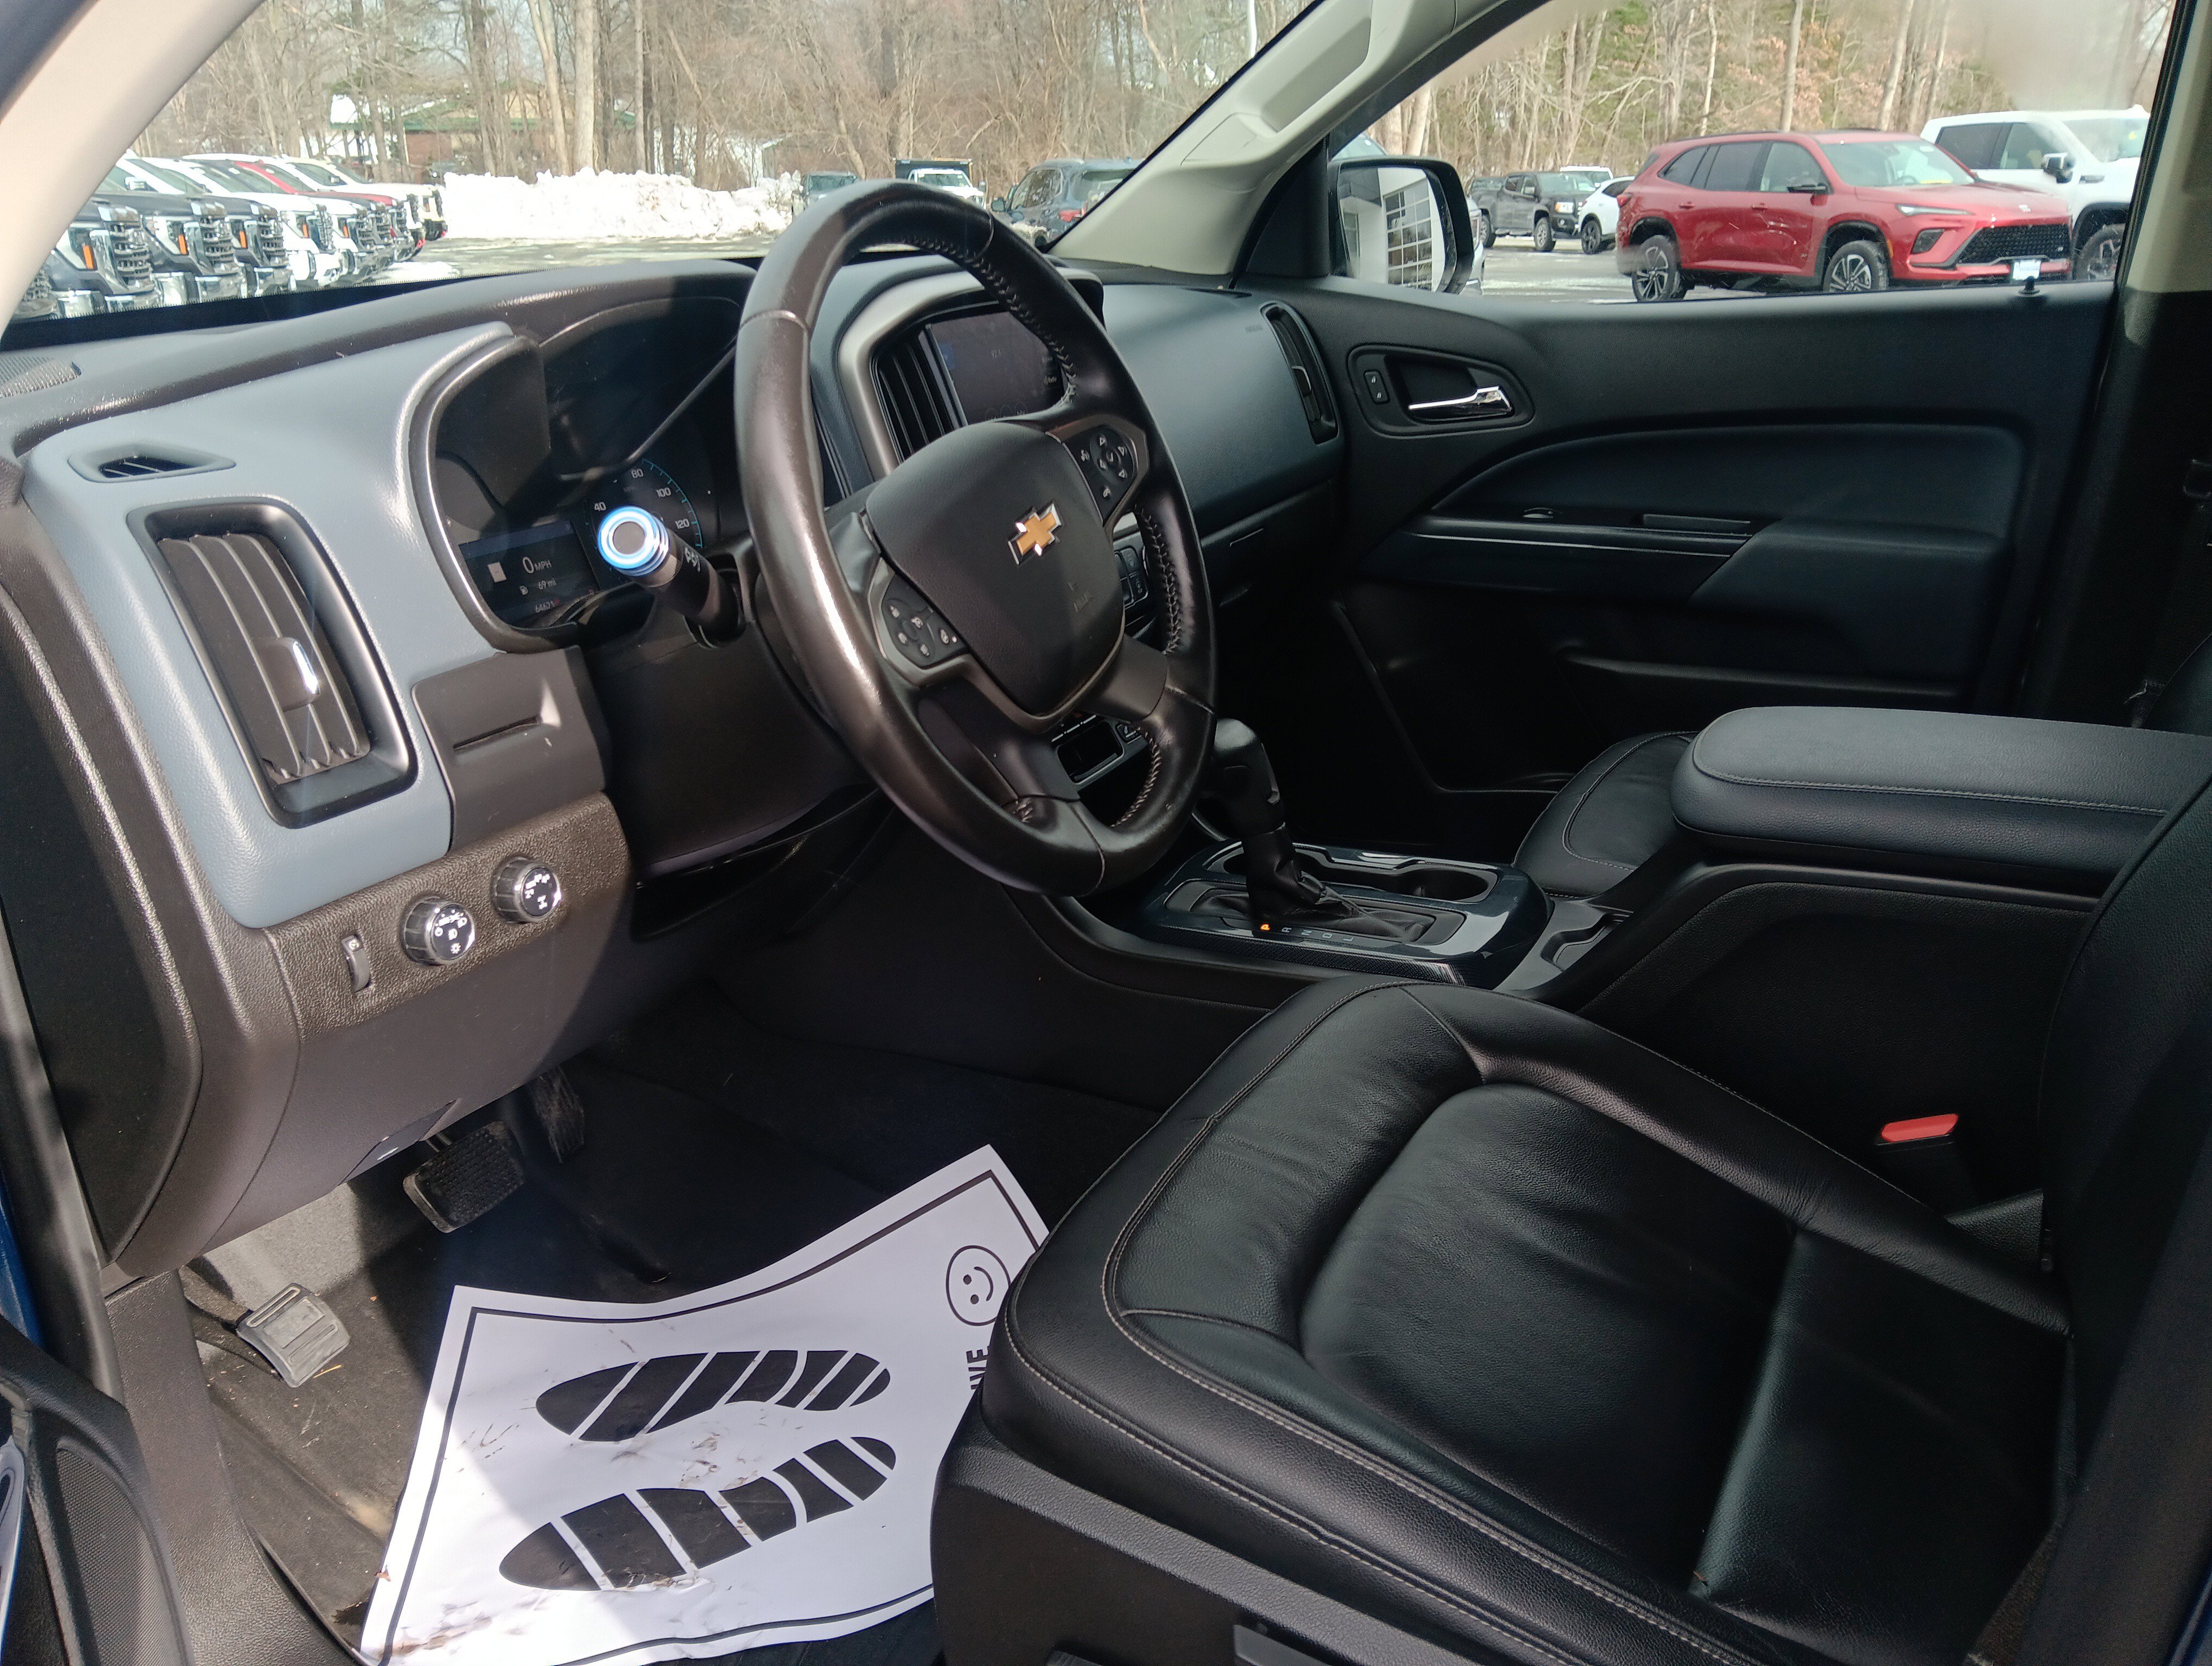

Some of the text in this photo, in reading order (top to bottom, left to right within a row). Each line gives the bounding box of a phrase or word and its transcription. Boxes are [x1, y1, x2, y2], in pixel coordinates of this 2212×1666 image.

[631, 468, 644, 479] 80
[656, 487, 672, 498] 100
[594, 501, 607, 511] 40
[674, 518, 690, 529] 120
[522, 556, 552, 574] 0 MPH
